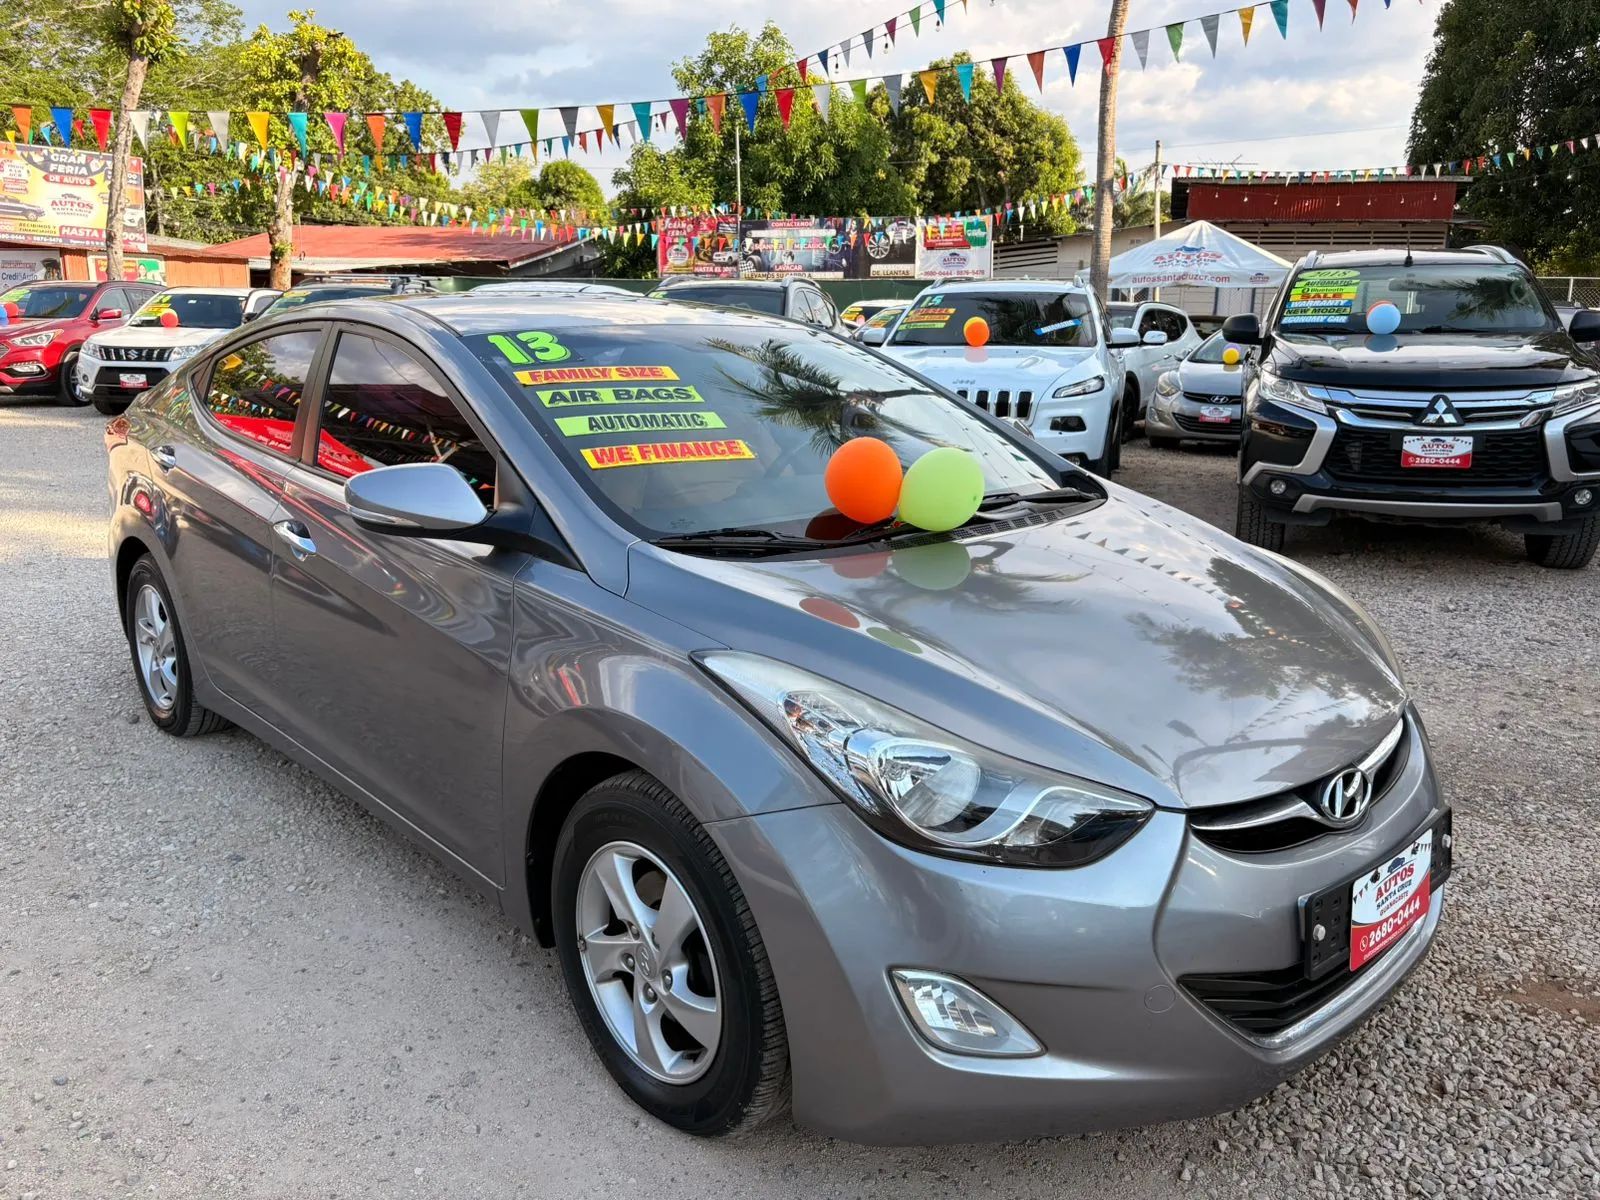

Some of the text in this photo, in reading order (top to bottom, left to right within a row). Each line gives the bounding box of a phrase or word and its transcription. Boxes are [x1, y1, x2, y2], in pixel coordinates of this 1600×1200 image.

[50, 153, 87, 164] GRAN
[49, 163, 89, 176] FERIA
[49, 174, 91, 186] DE AUTOS
[50, 200, 94, 210] AUTOS
[61, 226, 98, 238] HASTA
[1152, 252, 1224, 262] AUTOS
[1309, 270, 1351, 278] 2018
[1290, 300, 1349, 308] WARRANTY
[1312, 307, 1351, 315] MODEL
[1282, 315, 1350, 324] ECONOMY CAR
[487, 332, 572, 364] 13
[529, 366, 668, 383] FAMILY SIZE
[548, 386, 696, 405] AIR BAGS
[588, 412, 708, 432] AUTOMATIC
[590, 440, 746, 466] WE FINANCE
[1415, 456, 1460, 464] 2680-0444
[1376, 863, 1415, 902] AUTOS
[1376, 879, 1413, 910] SANTA CRUZ
[1369, 896, 1421, 948] 2680-0444
